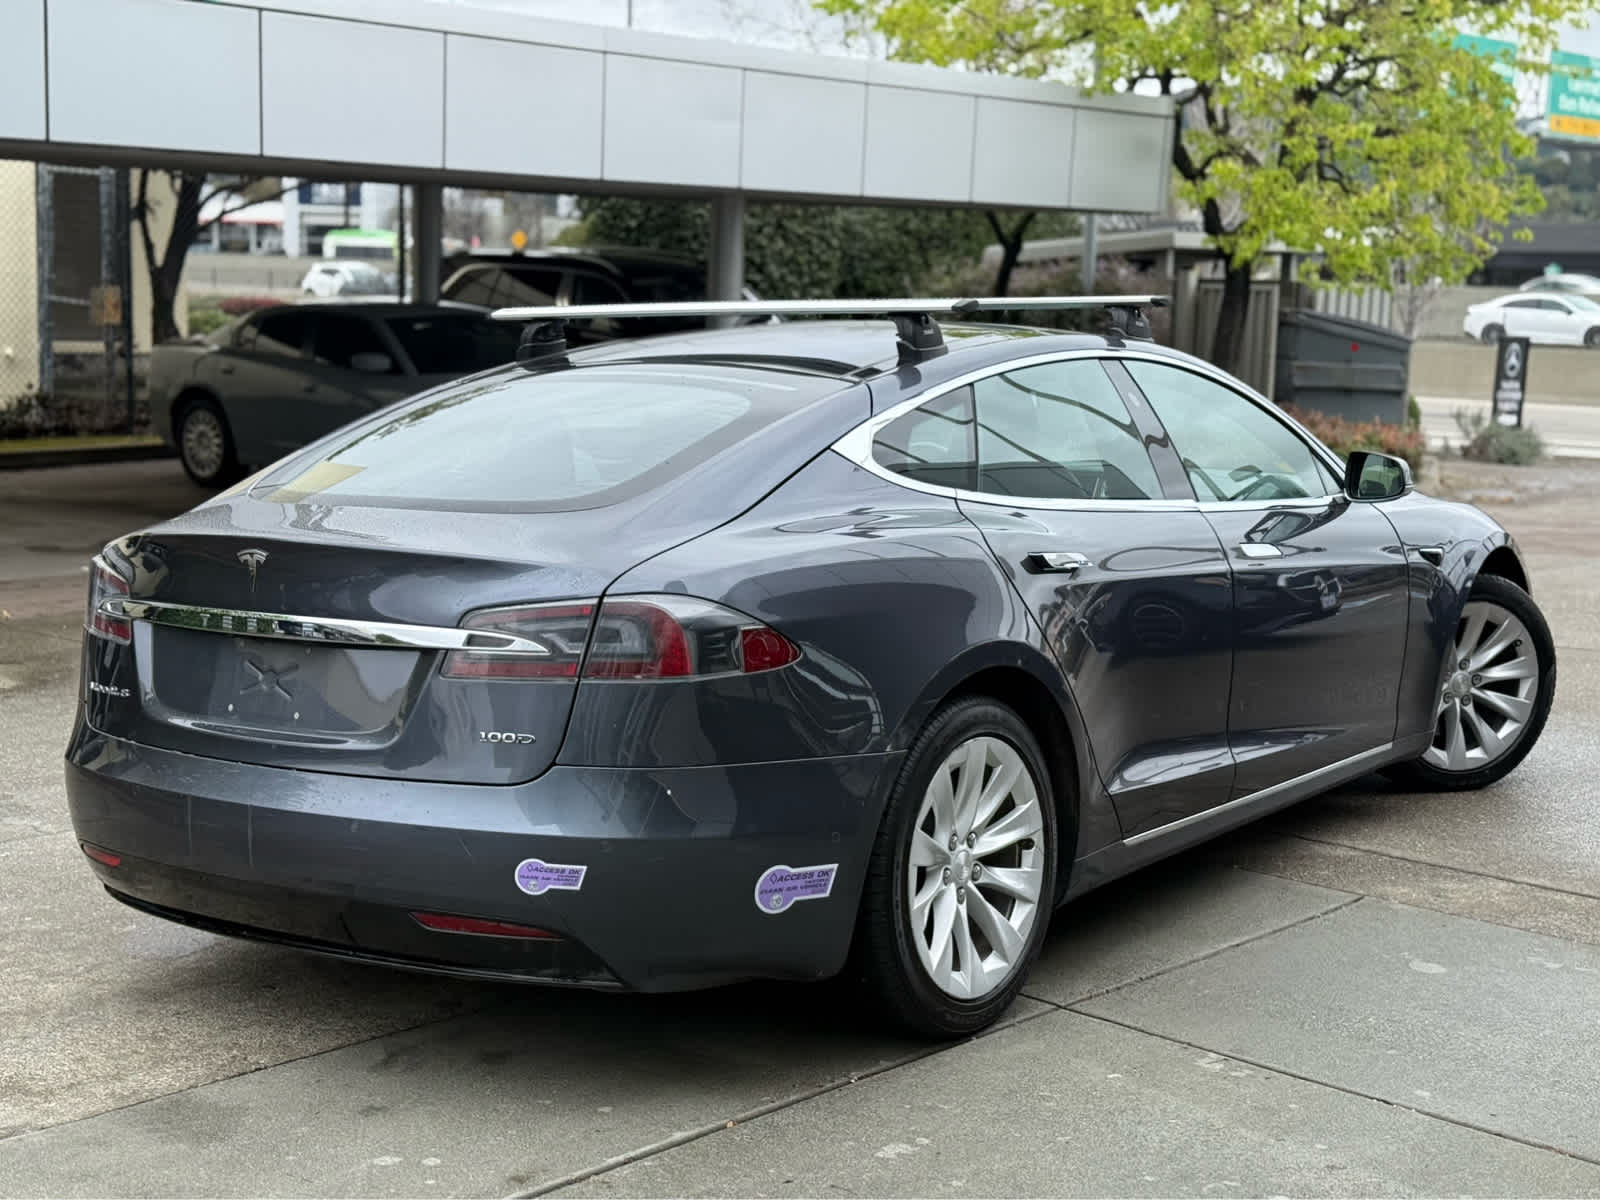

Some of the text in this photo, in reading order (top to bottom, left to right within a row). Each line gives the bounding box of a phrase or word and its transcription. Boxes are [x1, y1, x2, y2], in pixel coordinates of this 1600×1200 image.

[199, 613, 314, 637] TESLA
[479, 731, 536, 744] 100D
[777, 872, 814, 883] ACCESS
[817, 870, 829, 878] OK
